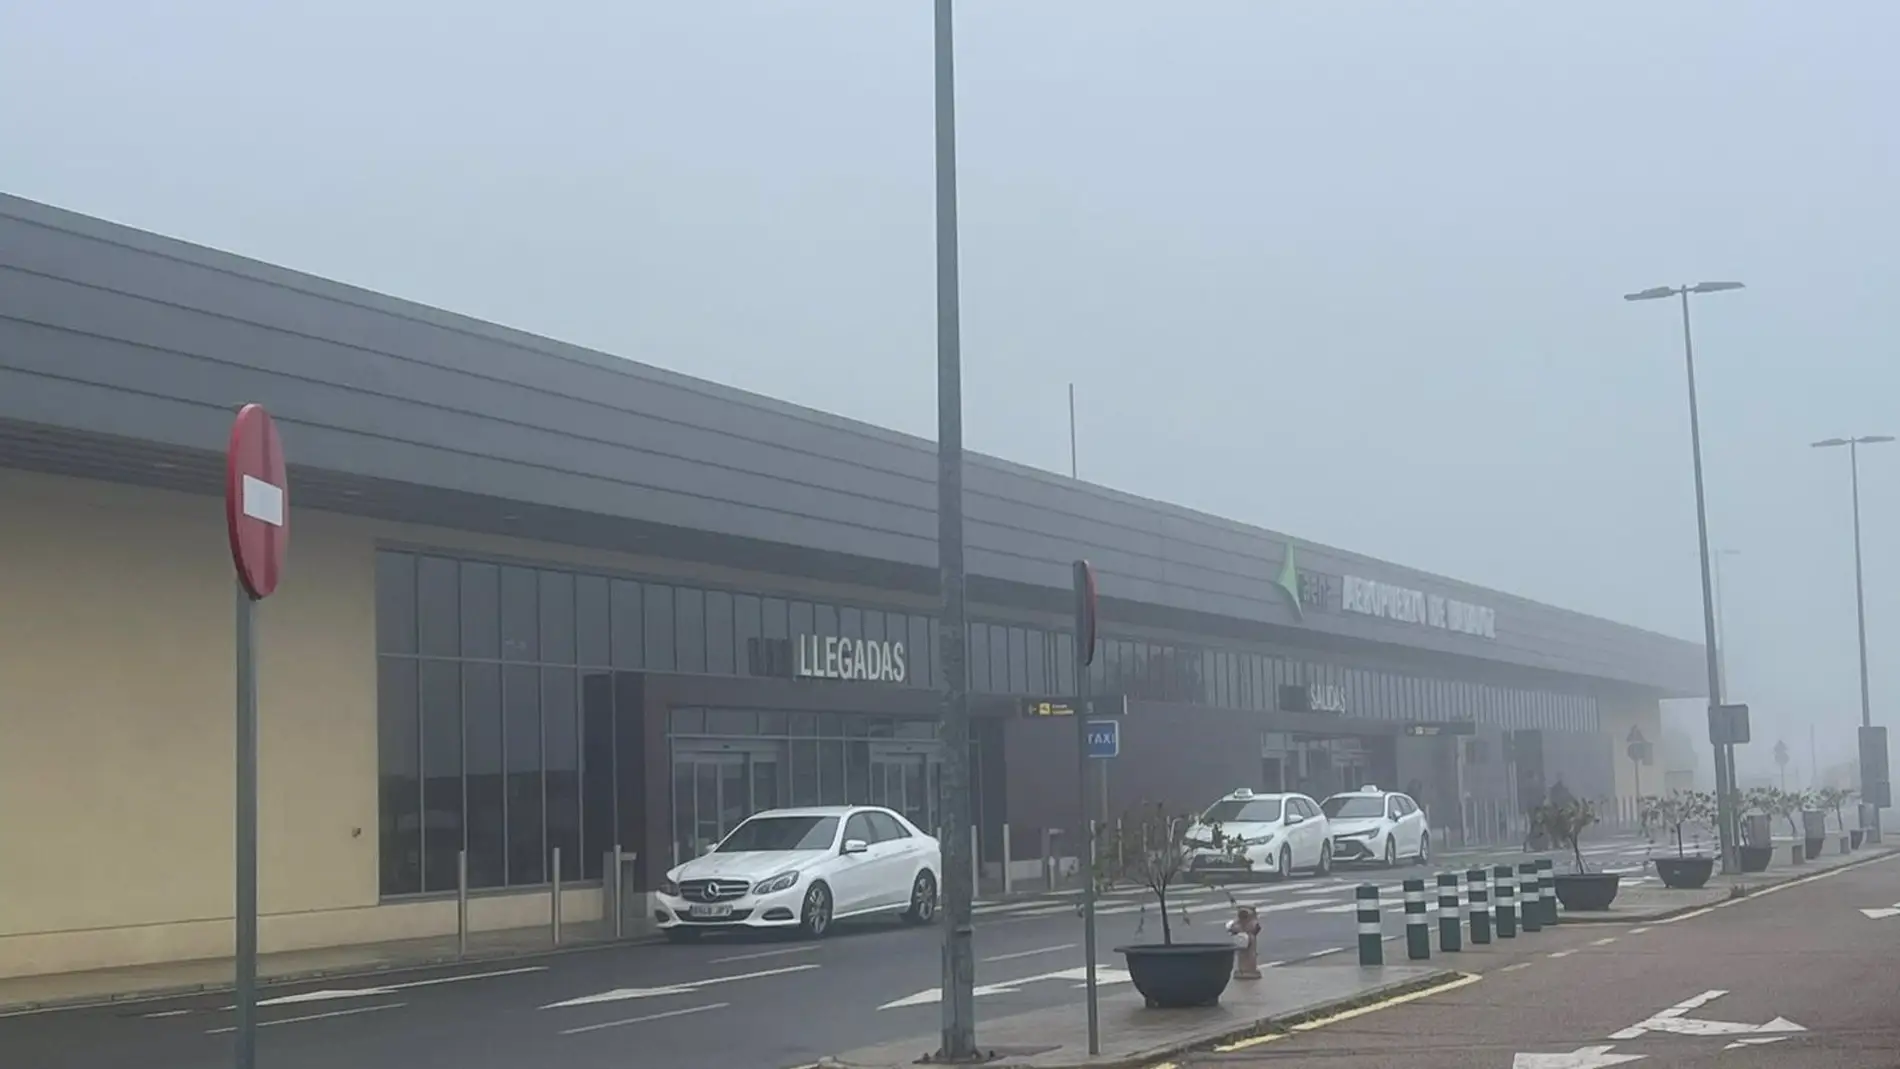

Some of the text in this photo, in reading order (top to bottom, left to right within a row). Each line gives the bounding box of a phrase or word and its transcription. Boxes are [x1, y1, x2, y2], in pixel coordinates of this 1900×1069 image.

[1343, 575, 1426, 626] AEROPUERTO
[800, 634, 905, 682] LLEGADAS
[1310, 683, 1346, 714] SALIDAS
[1087, 733, 1115, 745] TAXI
